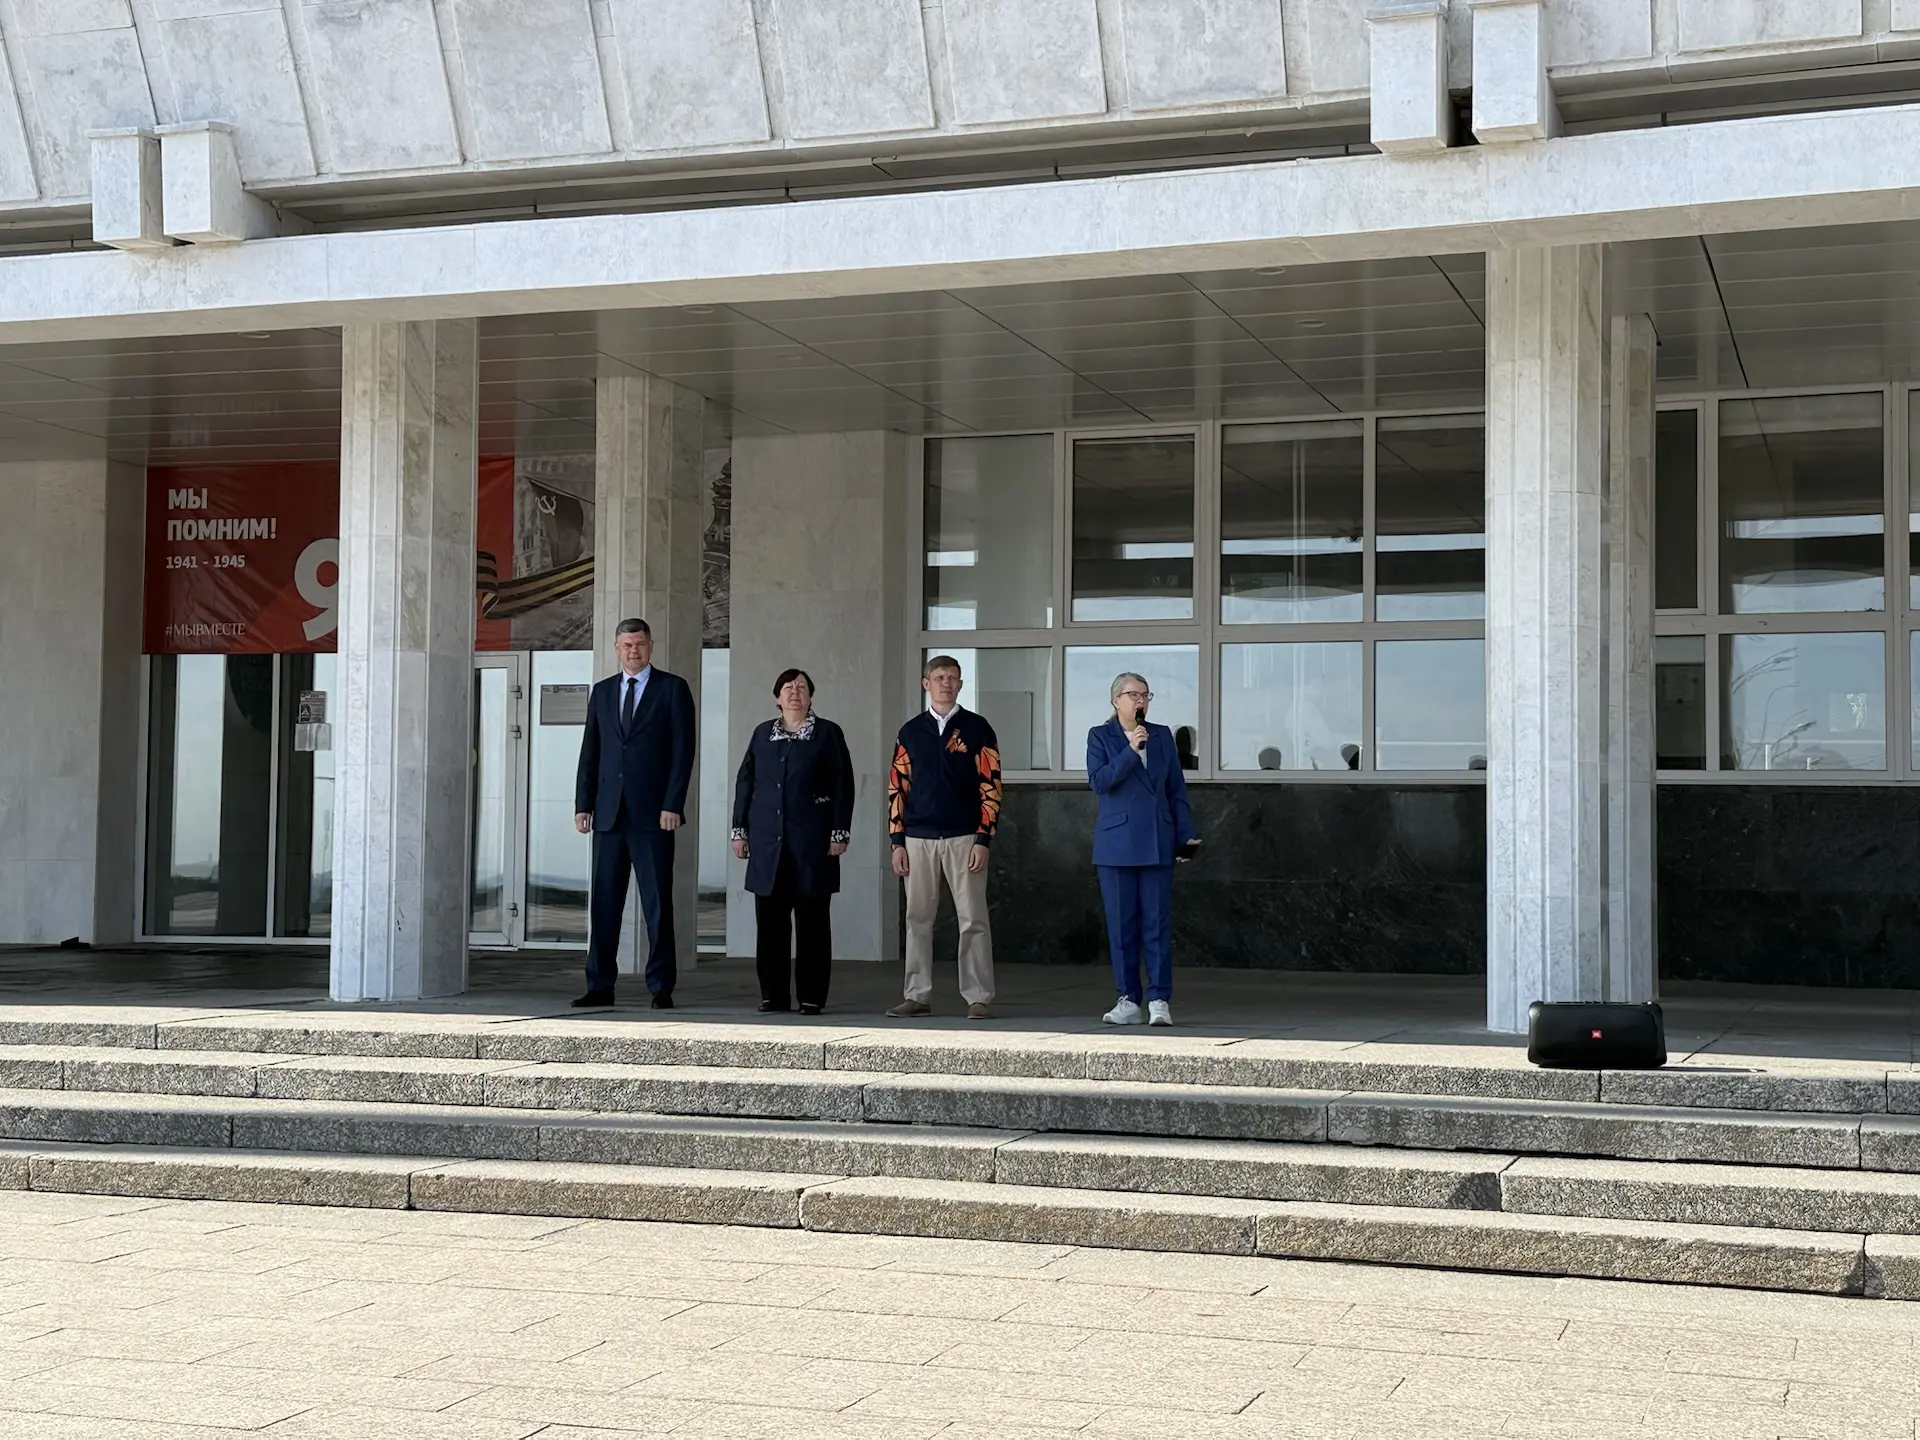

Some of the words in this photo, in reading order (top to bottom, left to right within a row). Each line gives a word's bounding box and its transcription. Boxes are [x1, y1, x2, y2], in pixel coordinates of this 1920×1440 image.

[168, 488, 207, 510] МЫ
[167, 518, 277, 541] ПОМНИМ!
[166, 555, 198, 569] 1941
[212, 555, 246, 568] 1945
[165, 623, 246, 636] #МЫВМЕСТЕ
